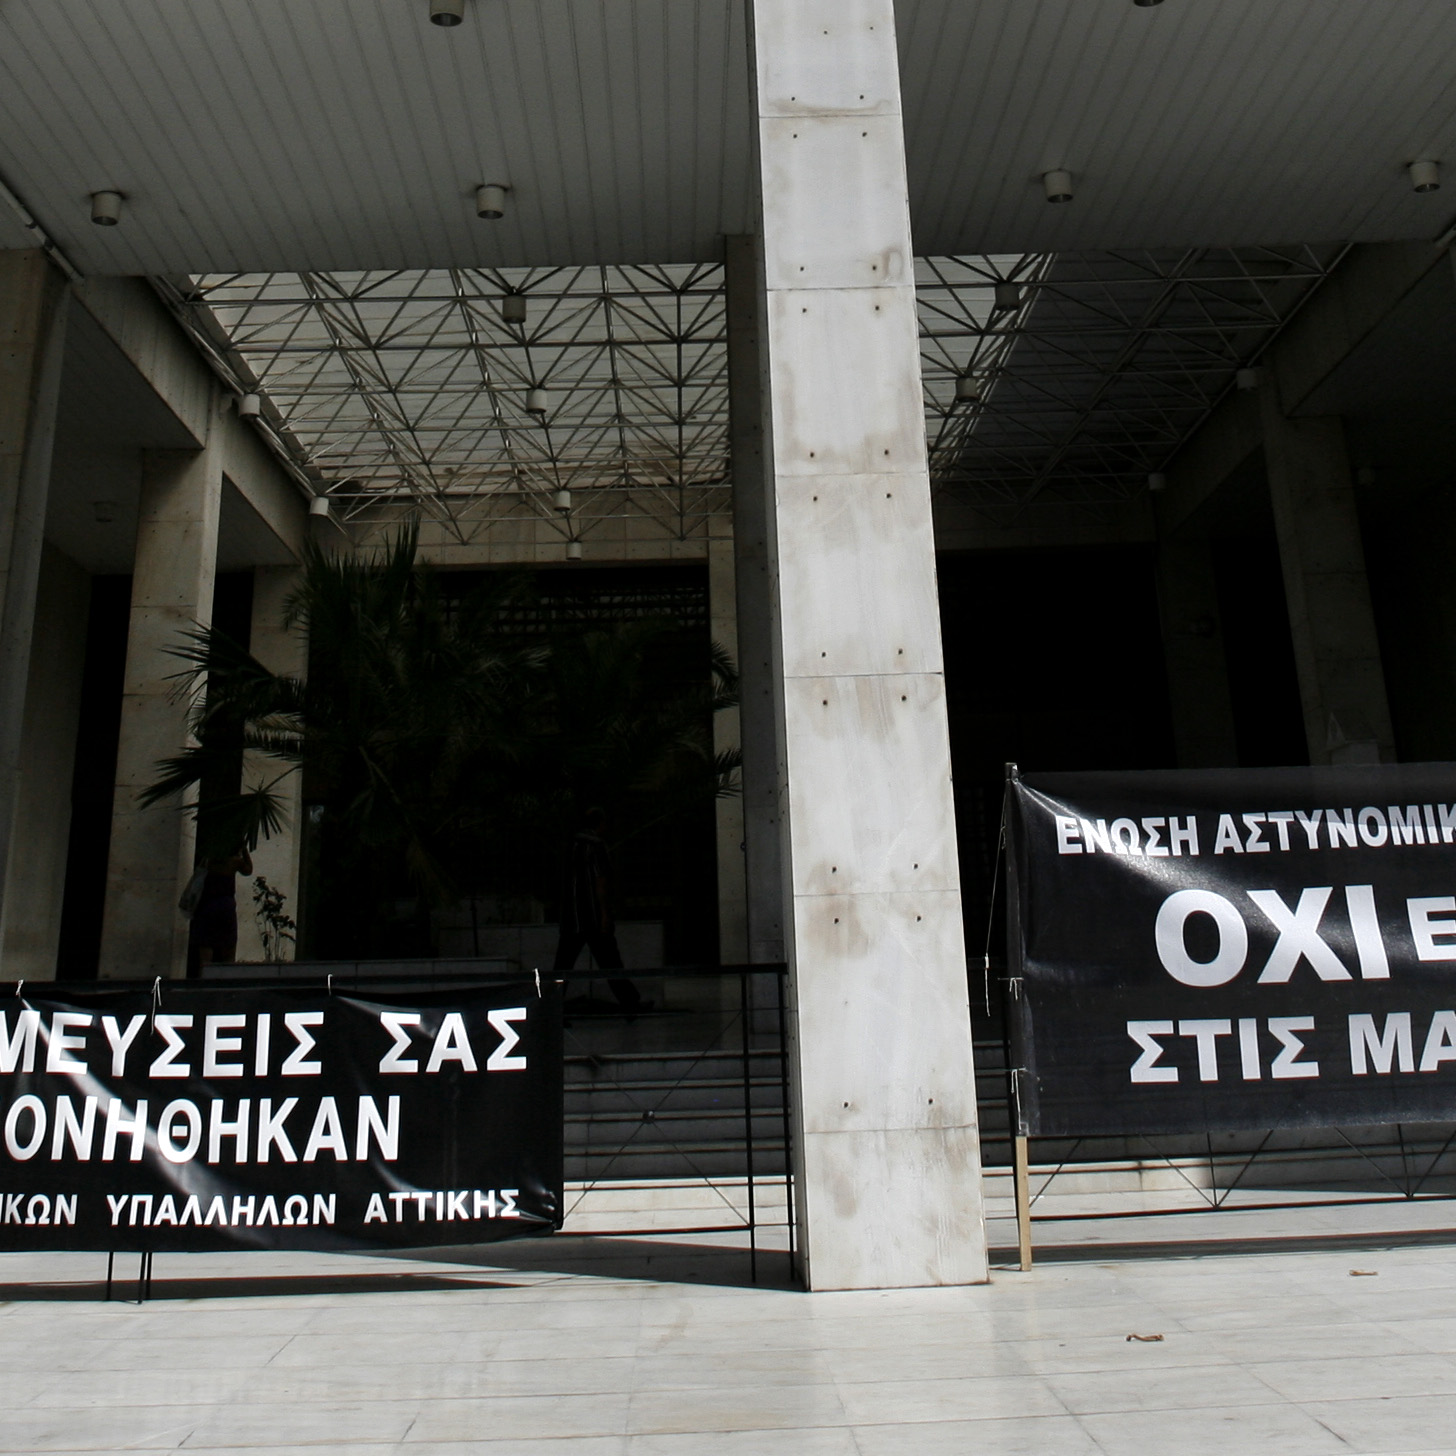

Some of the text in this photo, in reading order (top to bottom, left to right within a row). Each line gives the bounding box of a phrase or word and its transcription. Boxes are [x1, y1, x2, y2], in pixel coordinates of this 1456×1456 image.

[1055, 814, 1200, 857] ΕΝΩΣΗ
[1155, 884, 1394, 988] ΟΧΙ
[379, 1007, 528, 1075] ΣΑΣ
[1126, 1016, 1321, 1083] ΣΤΙΣ
[106, 1193, 337, 1227] ΥΠΑΛΛΗΛΩΝ
[363, 1188, 521, 1223] ΑΤΤΙΚΗΣ
